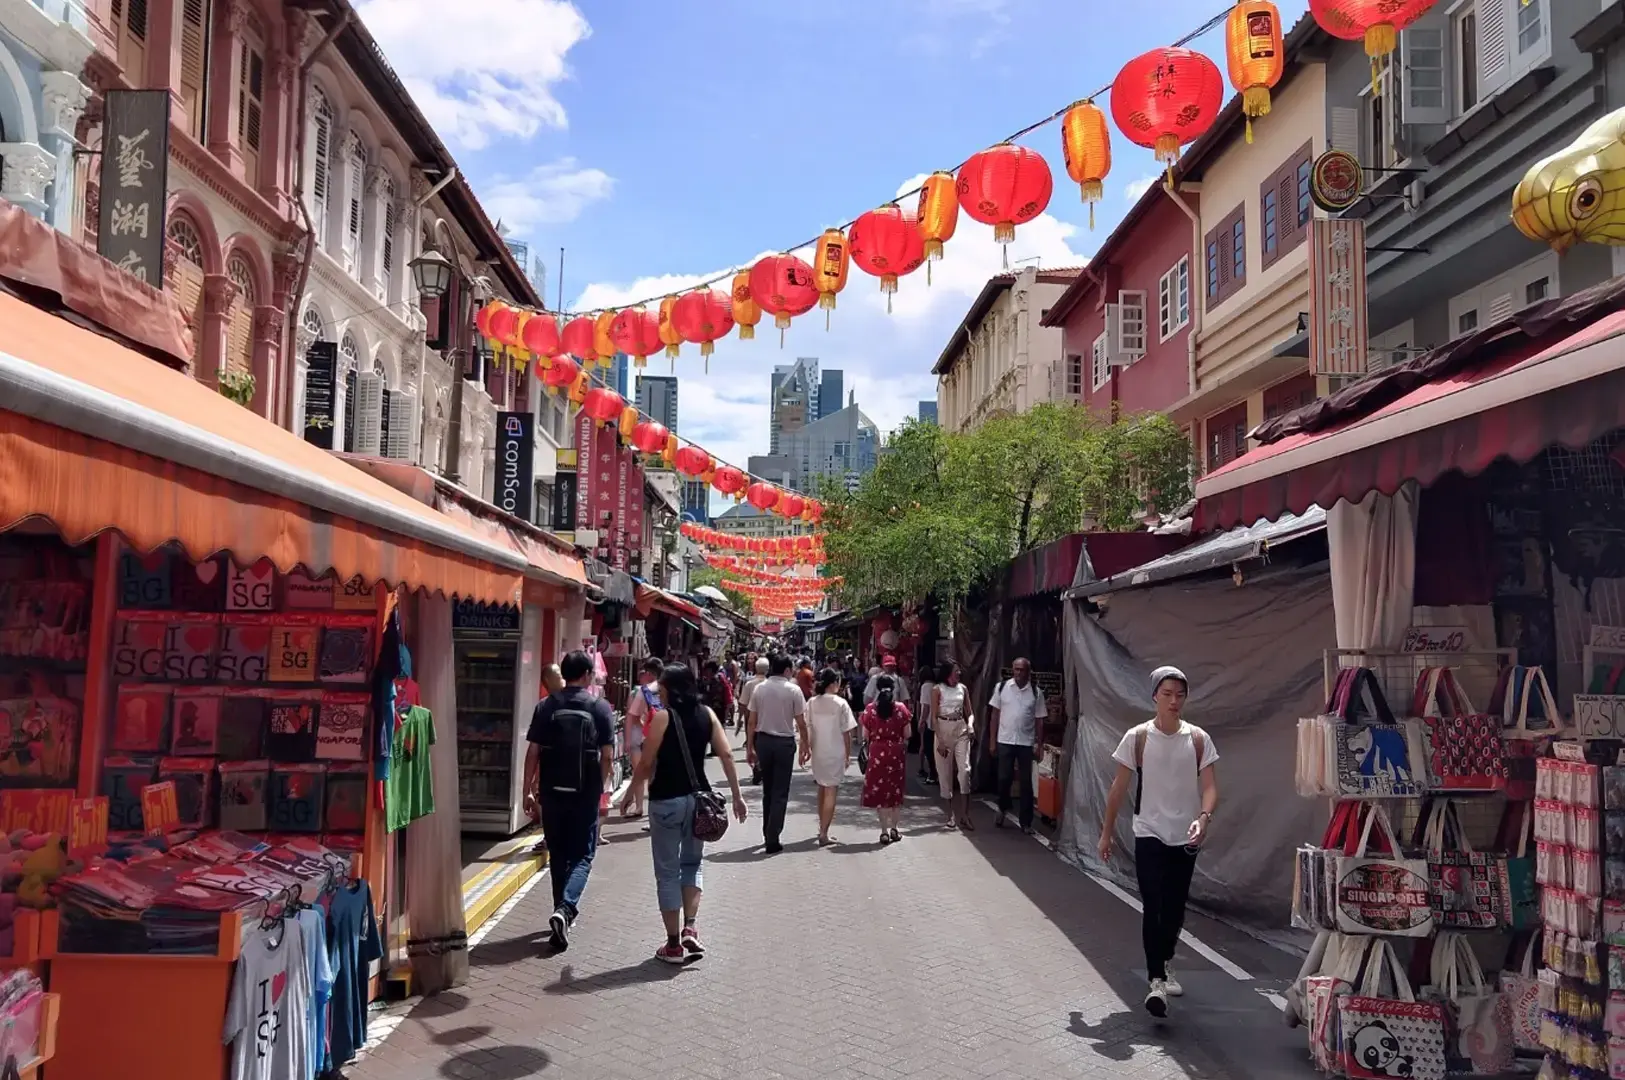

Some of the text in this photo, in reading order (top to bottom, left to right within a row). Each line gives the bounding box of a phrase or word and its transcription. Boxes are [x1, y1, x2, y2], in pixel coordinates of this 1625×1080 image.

[578, 417, 591, 475] CHINATOWN
[577, 477, 589, 524] HERITAGE
[233, 583, 271, 608] SG
[460, 615, 512, 628] DRINKS
[282, 632, 291, 648] I
[165, 655, 213, 681] SG
[213, 655, 270, 681] SG
[281, 651, 309, 669] SG
[1347, 890, 1426, 905] SINGAPORE
[257, 978, 270, 1018] I
[1351, 999, 1430, 1015] SINGAPORE
